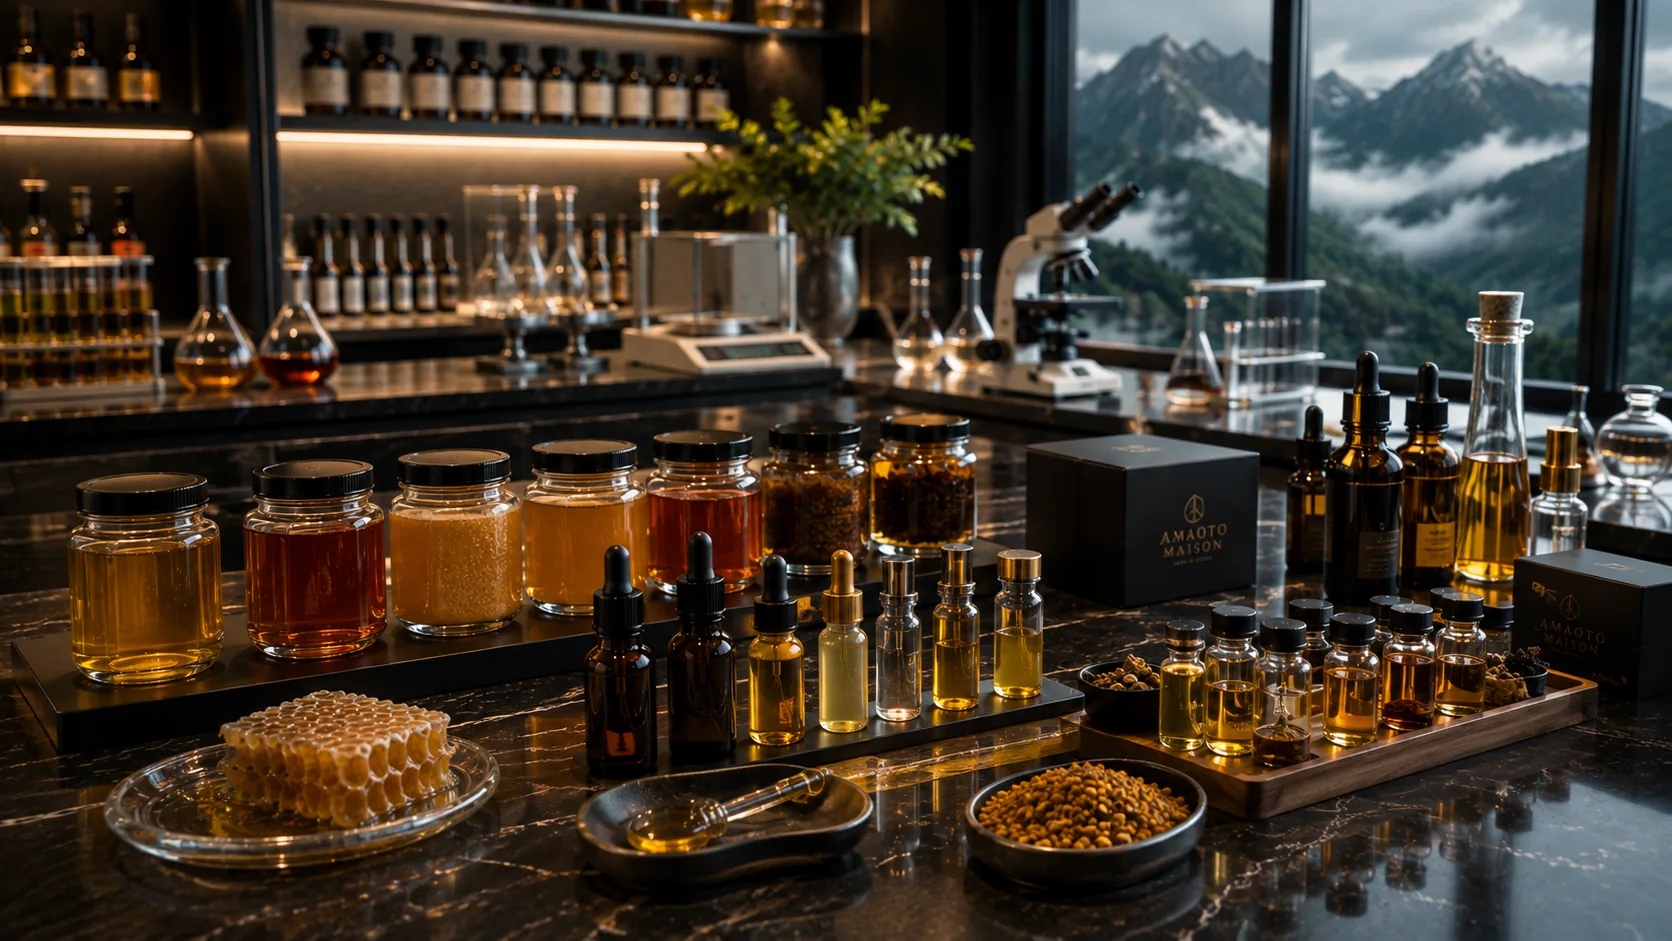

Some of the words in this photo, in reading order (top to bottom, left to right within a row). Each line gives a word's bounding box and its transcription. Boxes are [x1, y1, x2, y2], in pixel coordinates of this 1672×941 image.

[1160, 523, 1227, 546] AMAOTO
[1164, 540, 1222, 558] MAISON
[1540, 619, 1605, 644] AMAOTO
[1543, 633, 1598, 655] MAISON
